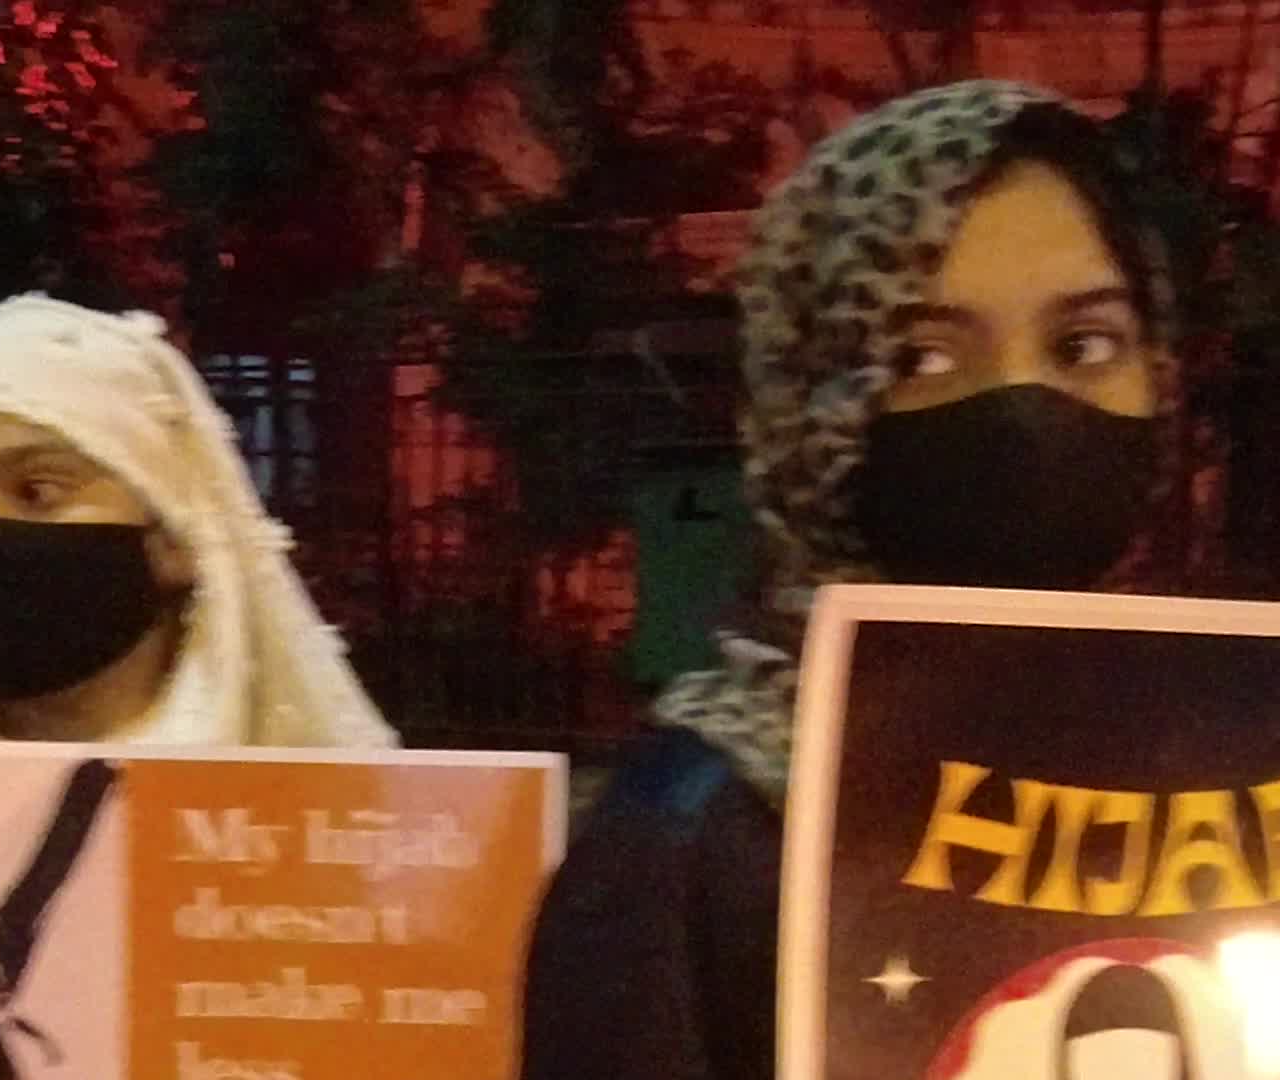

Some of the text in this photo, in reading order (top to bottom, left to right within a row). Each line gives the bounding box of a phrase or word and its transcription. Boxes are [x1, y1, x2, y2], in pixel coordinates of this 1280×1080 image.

[169, 807, 482, 882] My hijab
[174, 966, 488, 1026] make me
